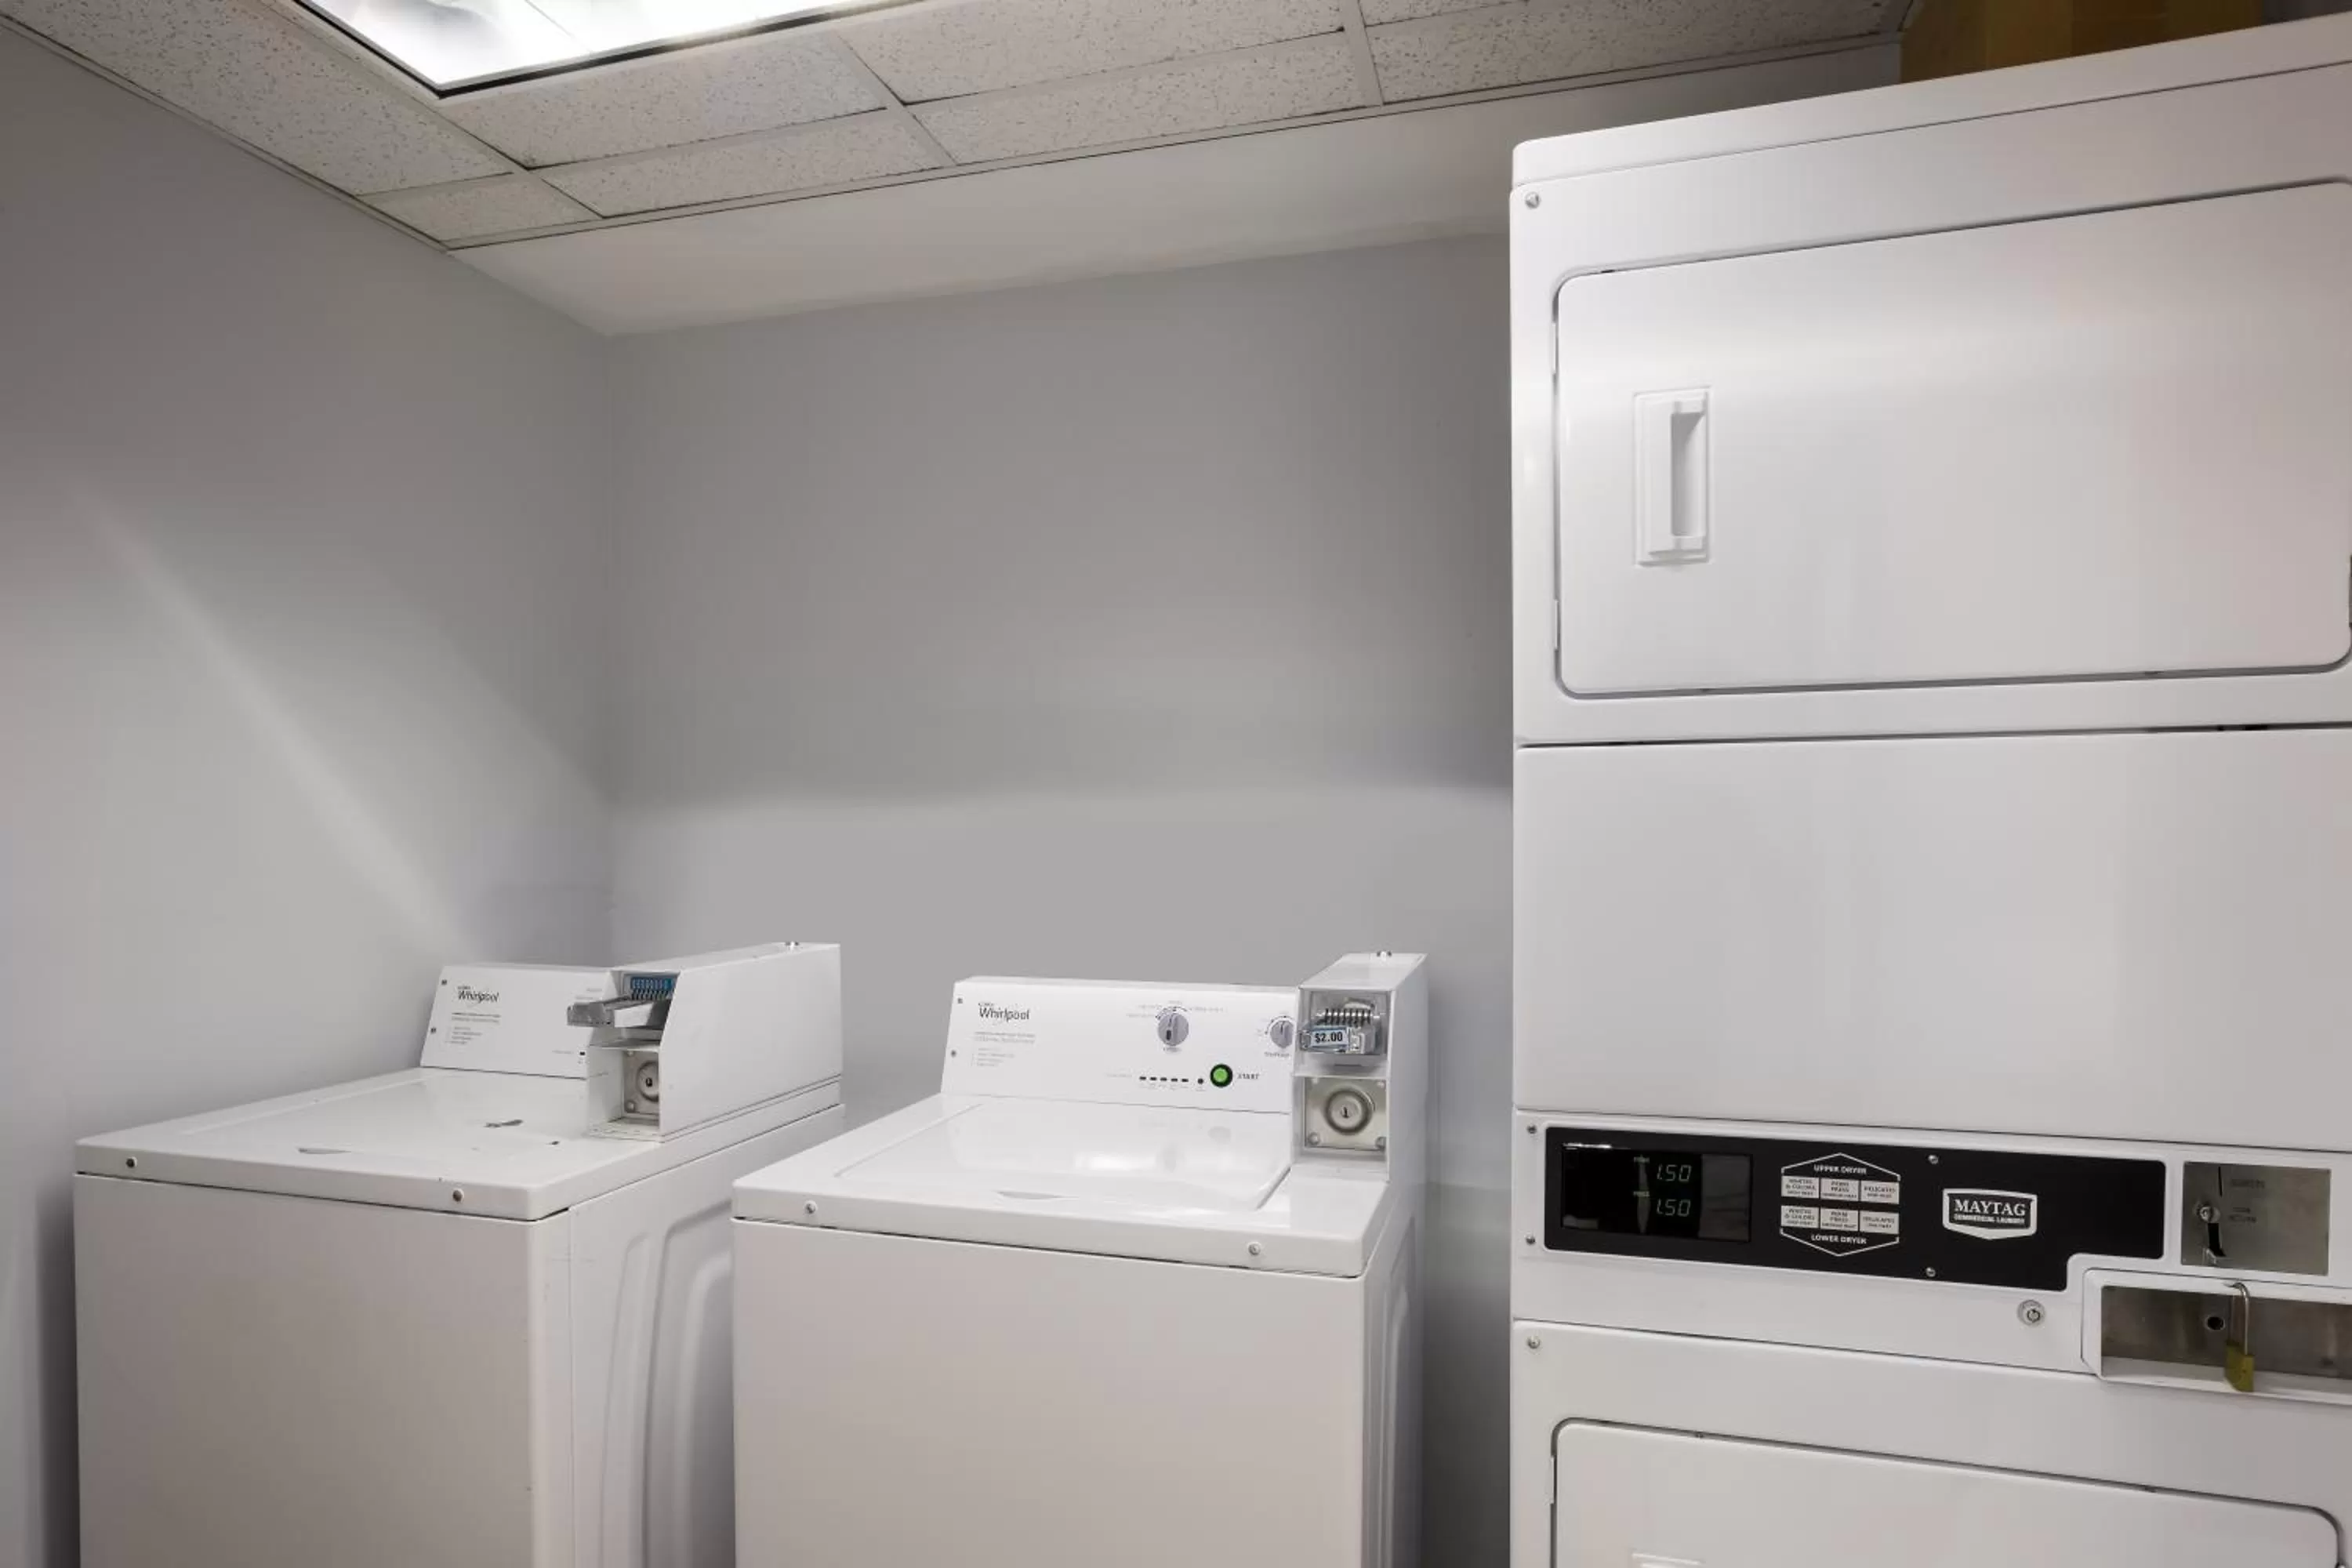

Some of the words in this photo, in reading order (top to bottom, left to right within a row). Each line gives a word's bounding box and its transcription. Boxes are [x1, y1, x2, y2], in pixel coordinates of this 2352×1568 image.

[458, 990, 499, 1004] Whirlpool
[978, 1007, 1030, 1022] Whirlpool
[1314, 1031, 1343, 1044] $2.00
[1813, 1163, 1840, 1174] UPPER
[1953, 1199, 2026, 1216] MAYTAG
[1810, 1233, 1839, 1243] LOWER
